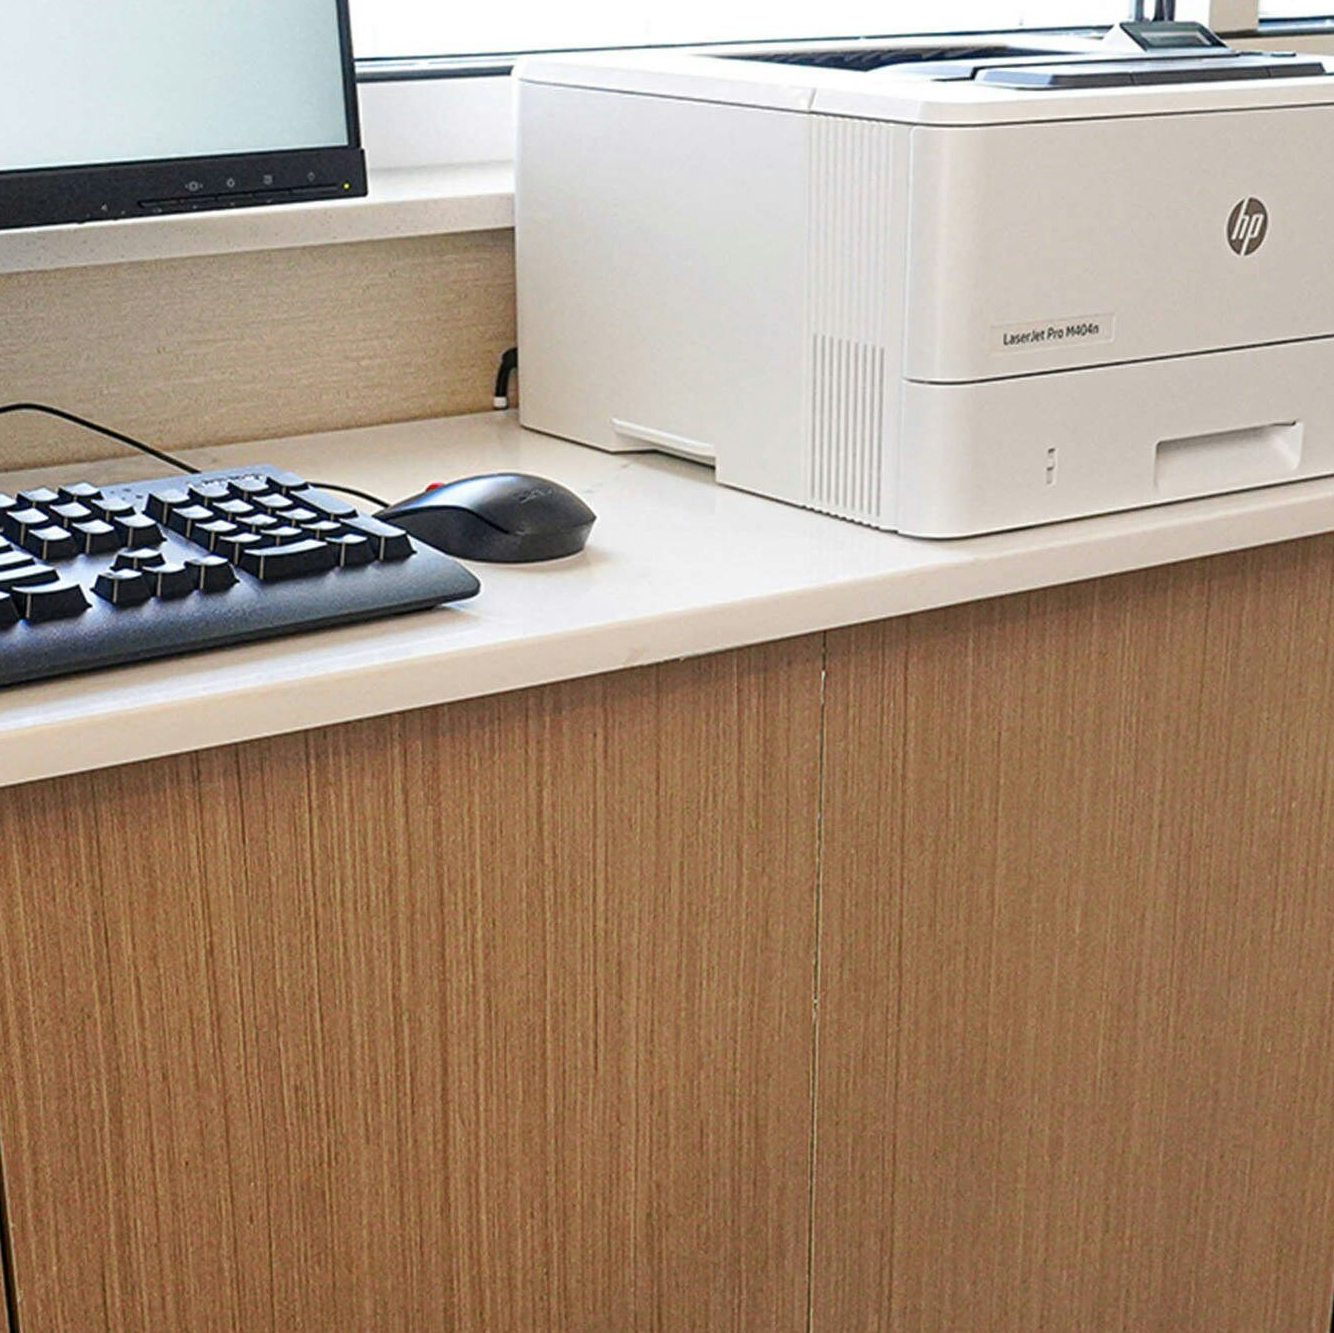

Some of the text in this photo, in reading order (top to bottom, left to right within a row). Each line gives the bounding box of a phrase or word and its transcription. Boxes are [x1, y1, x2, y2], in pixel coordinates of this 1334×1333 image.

[1228, 197, 1267, 256] hp
[1003, 329, 1045, 346] LaserJet
[1046, 326, 1064, 340] Pro
